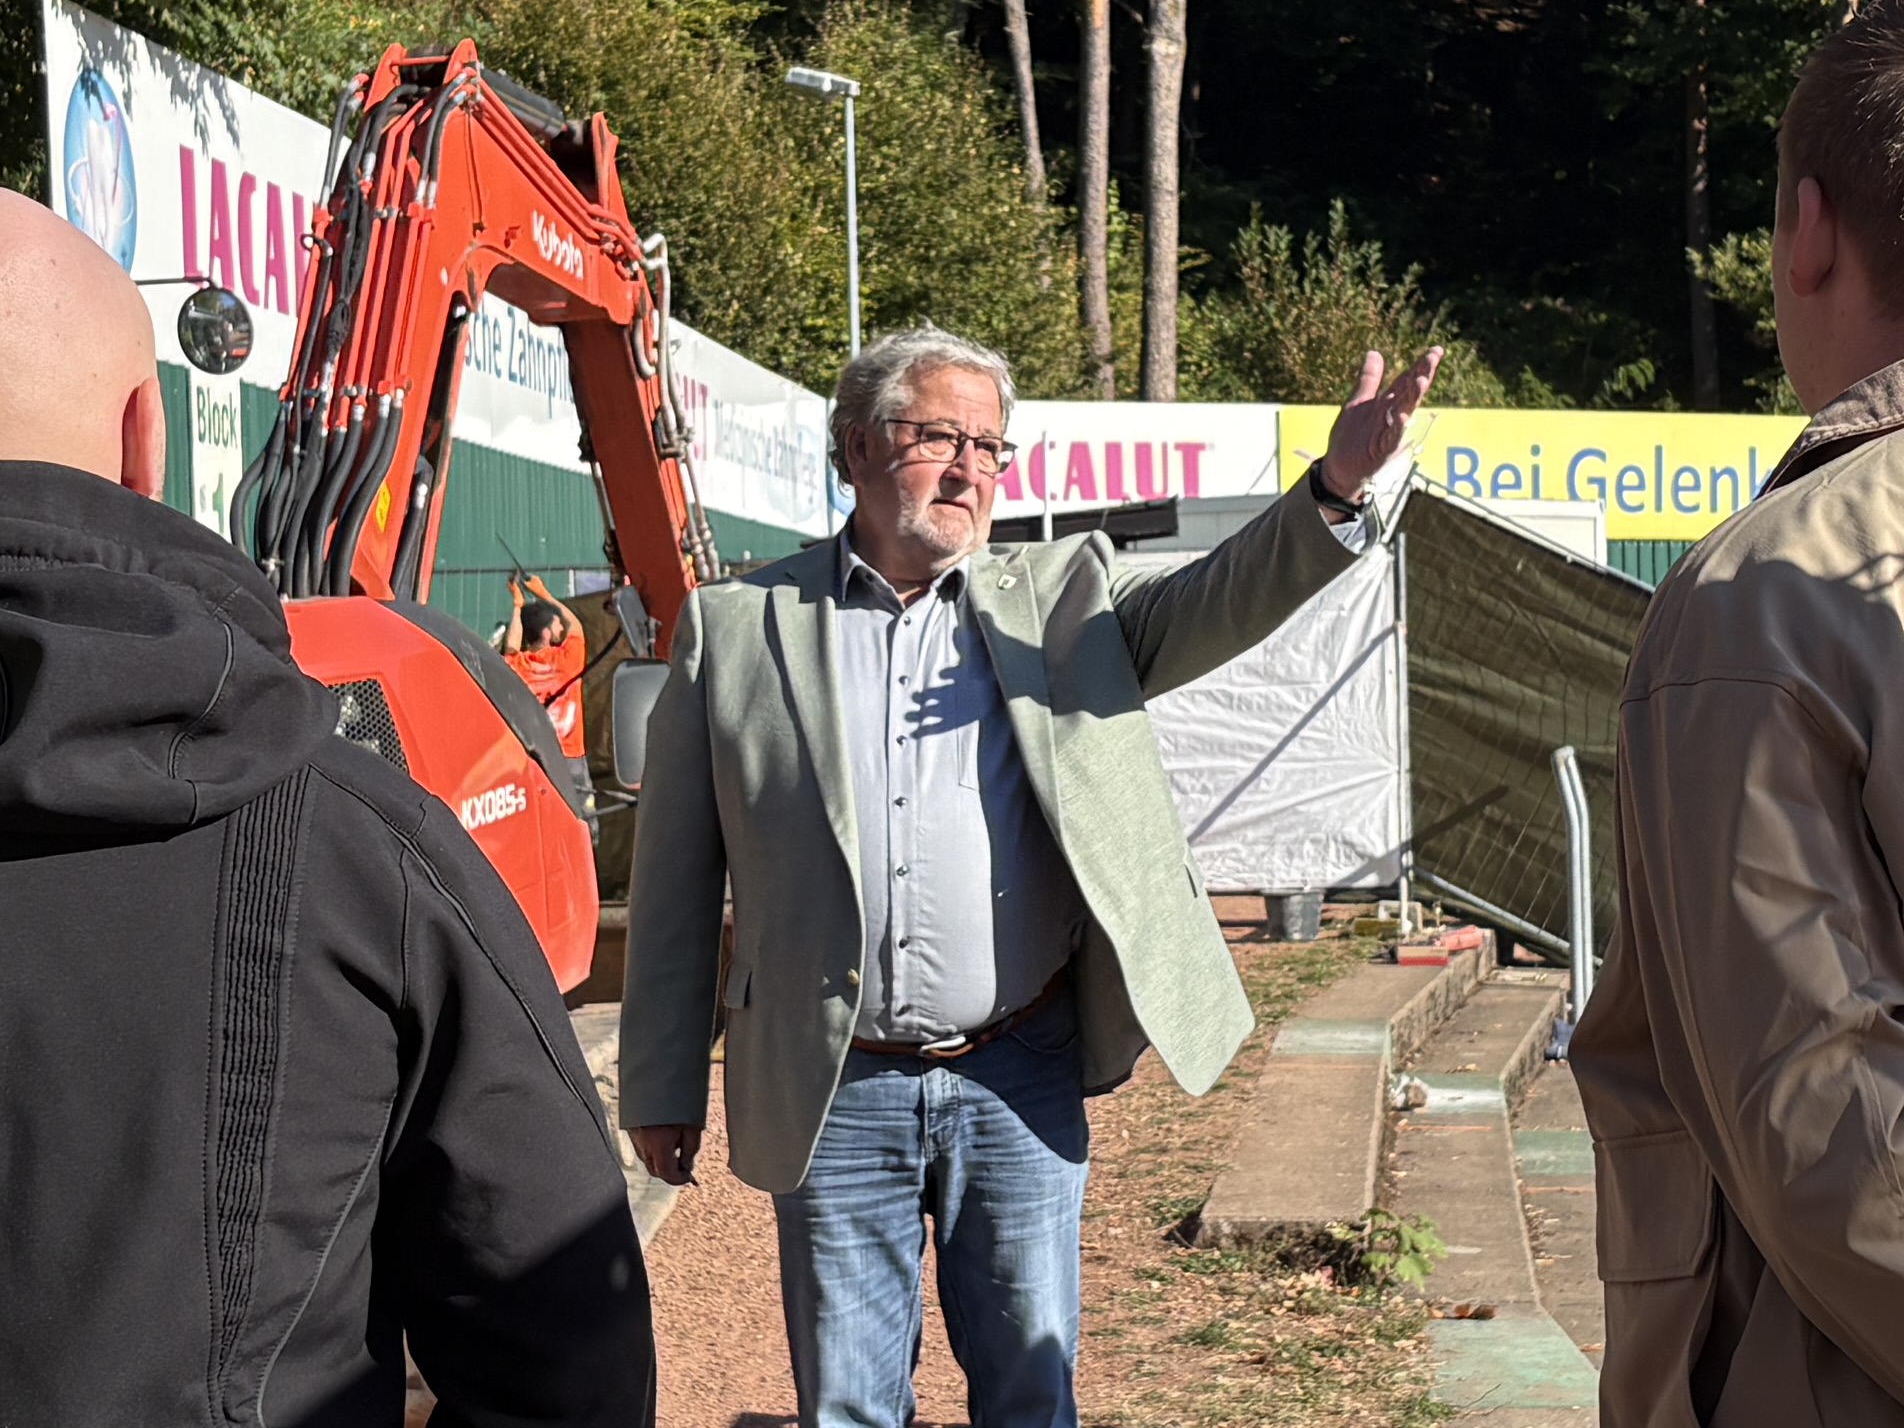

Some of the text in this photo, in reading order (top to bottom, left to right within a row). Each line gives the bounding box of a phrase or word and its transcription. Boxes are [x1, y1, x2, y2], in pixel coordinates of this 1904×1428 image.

[532, 210, 584, 281] Kubota
[197, 386, 238, 448] Block
[1446, 444, 1543, 499] Bei
[462, 783, 527, 830] KX085-5
